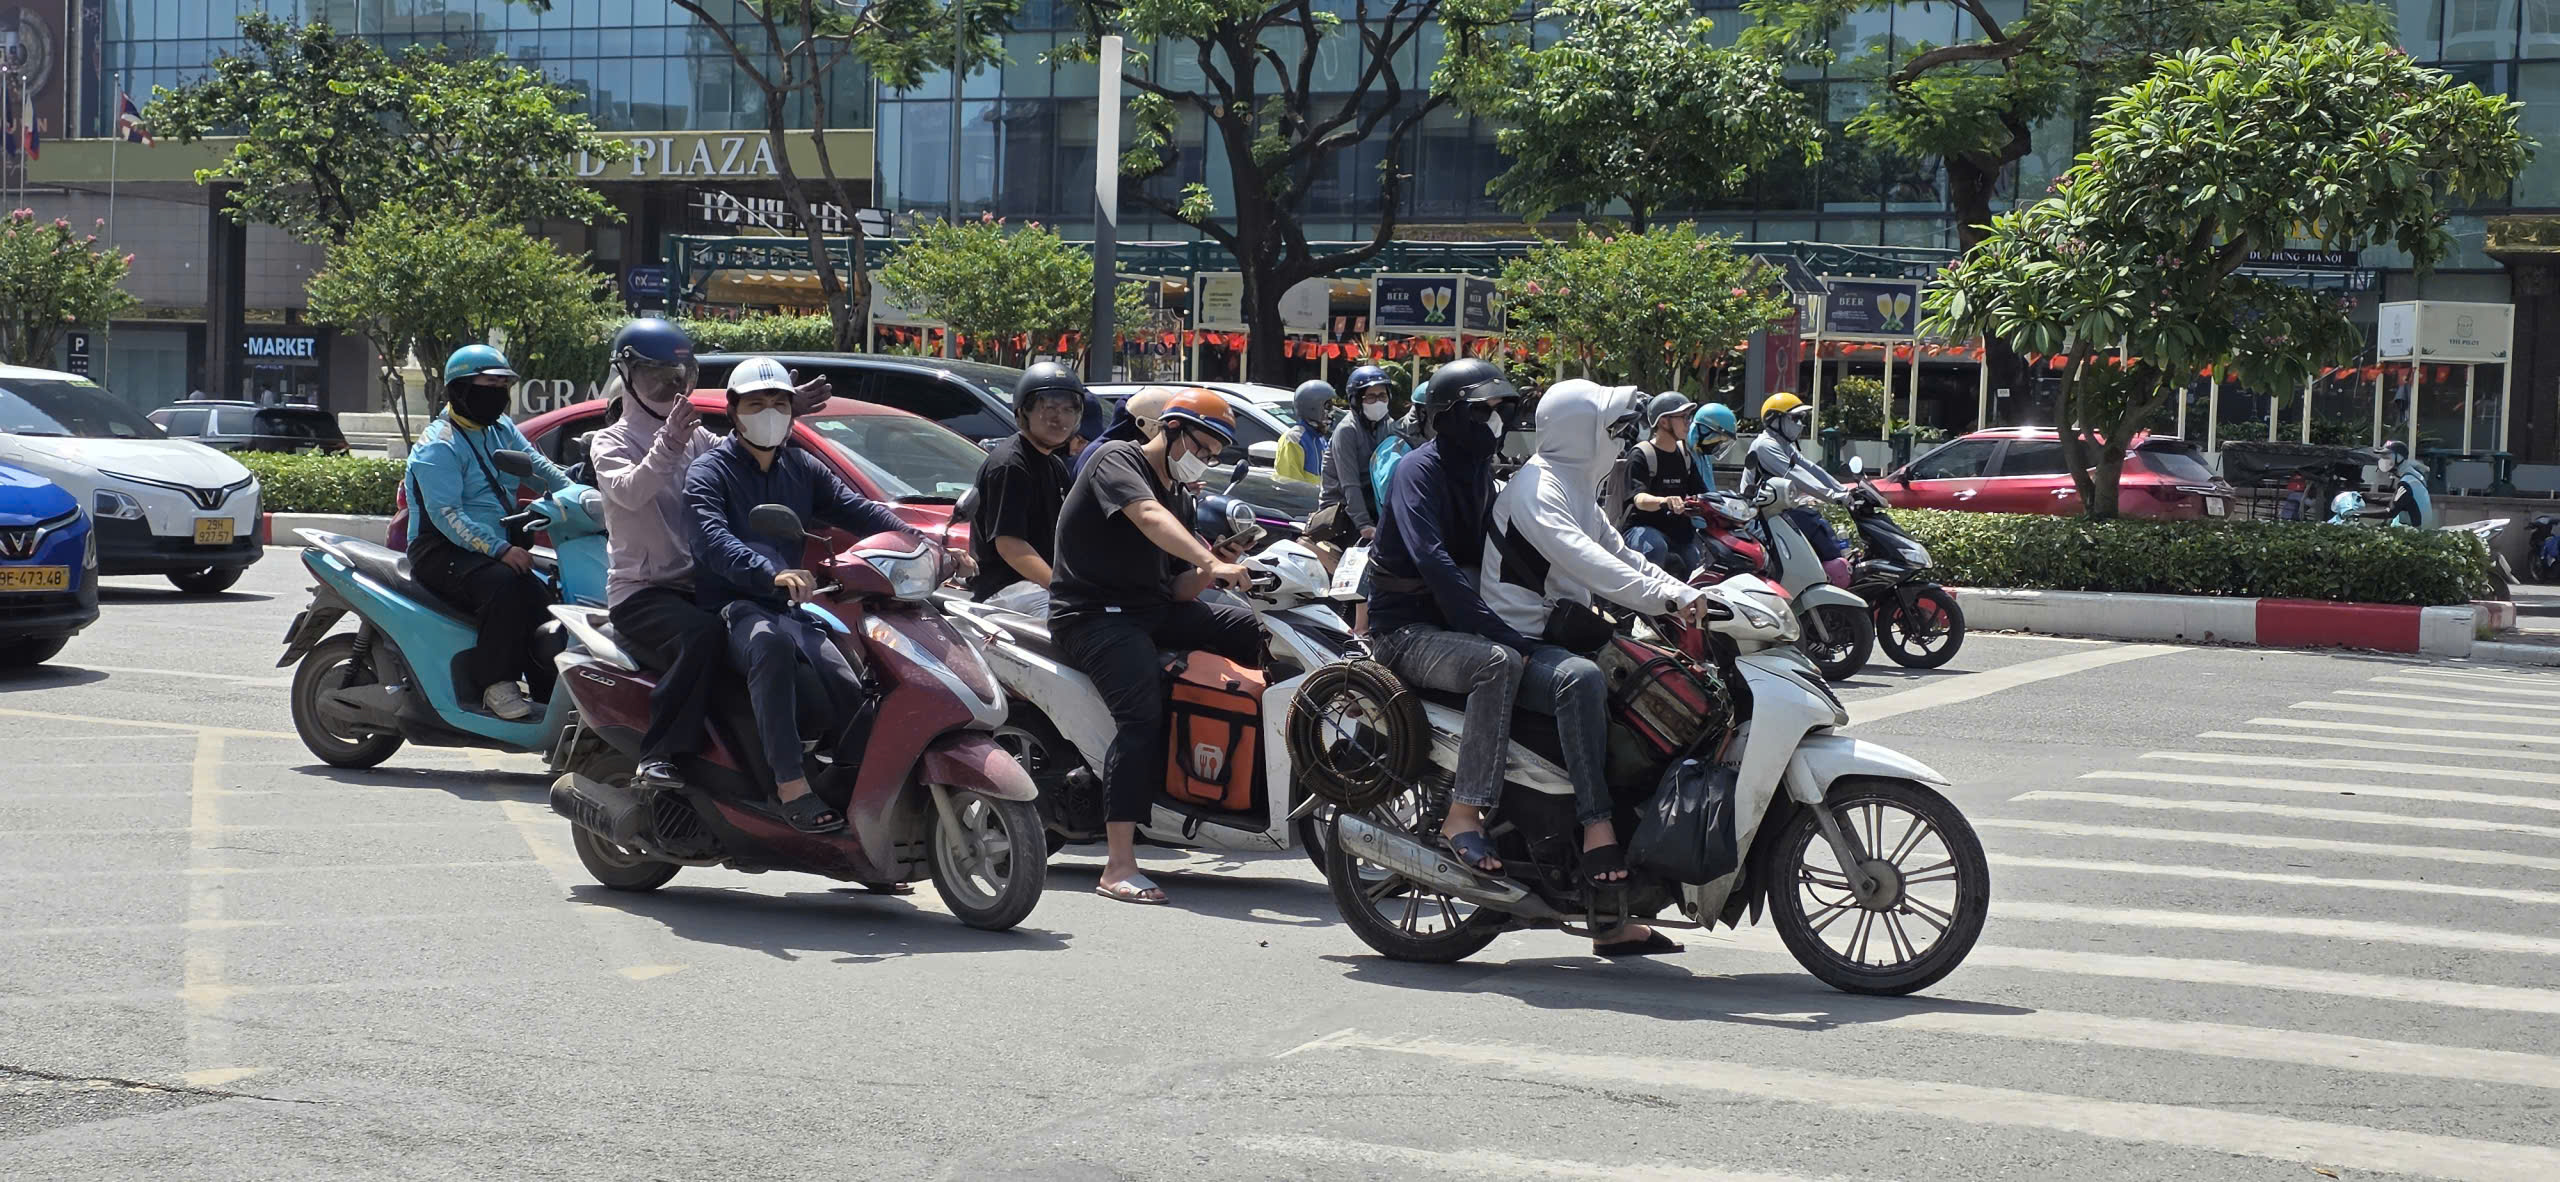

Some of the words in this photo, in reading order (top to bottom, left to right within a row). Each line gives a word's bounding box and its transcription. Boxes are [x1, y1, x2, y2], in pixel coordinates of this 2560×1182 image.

[630, 136, 780, 177] PLAZA
[1387, 292, 1410, 301] BEER
[1839, 297, 1864, 306] BEER
[75, 337, 85, 352] P
[207, 519, 224, 531] 29H
[579, 670, 616, 687] LEAD
